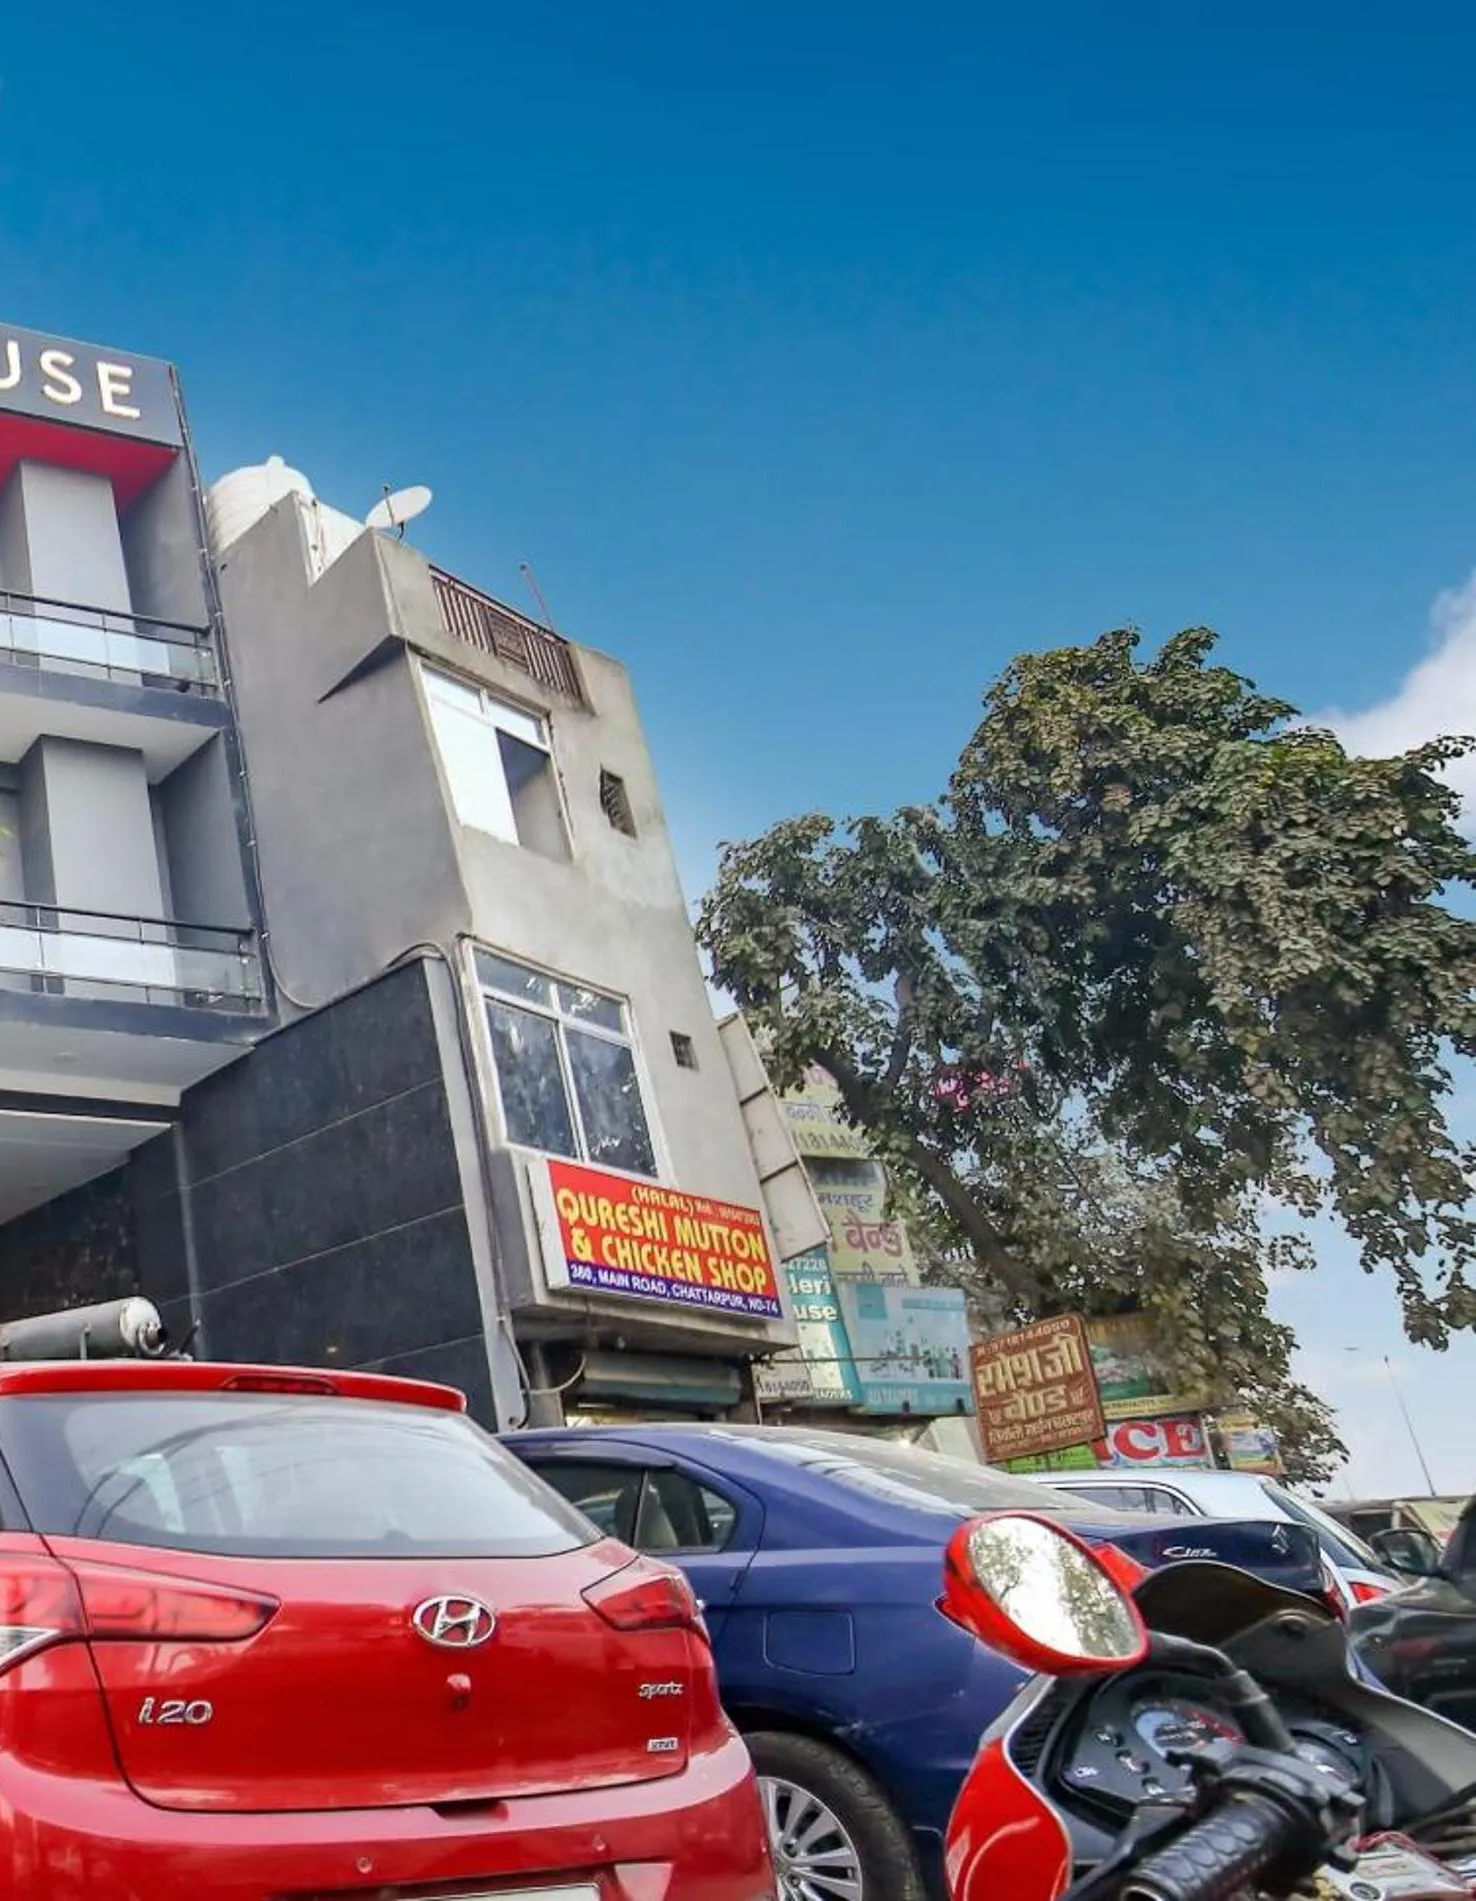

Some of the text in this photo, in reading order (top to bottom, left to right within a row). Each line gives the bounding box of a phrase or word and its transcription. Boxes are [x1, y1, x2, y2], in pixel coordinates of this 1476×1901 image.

[556, 1187, 669, 1240] QURESHI
[674, 1214, 767, 1263] MUTTON
[571, 1227, 767, 1294] & CHICKEN SHOP
[597, 1268, 630, 1288] MAIN
